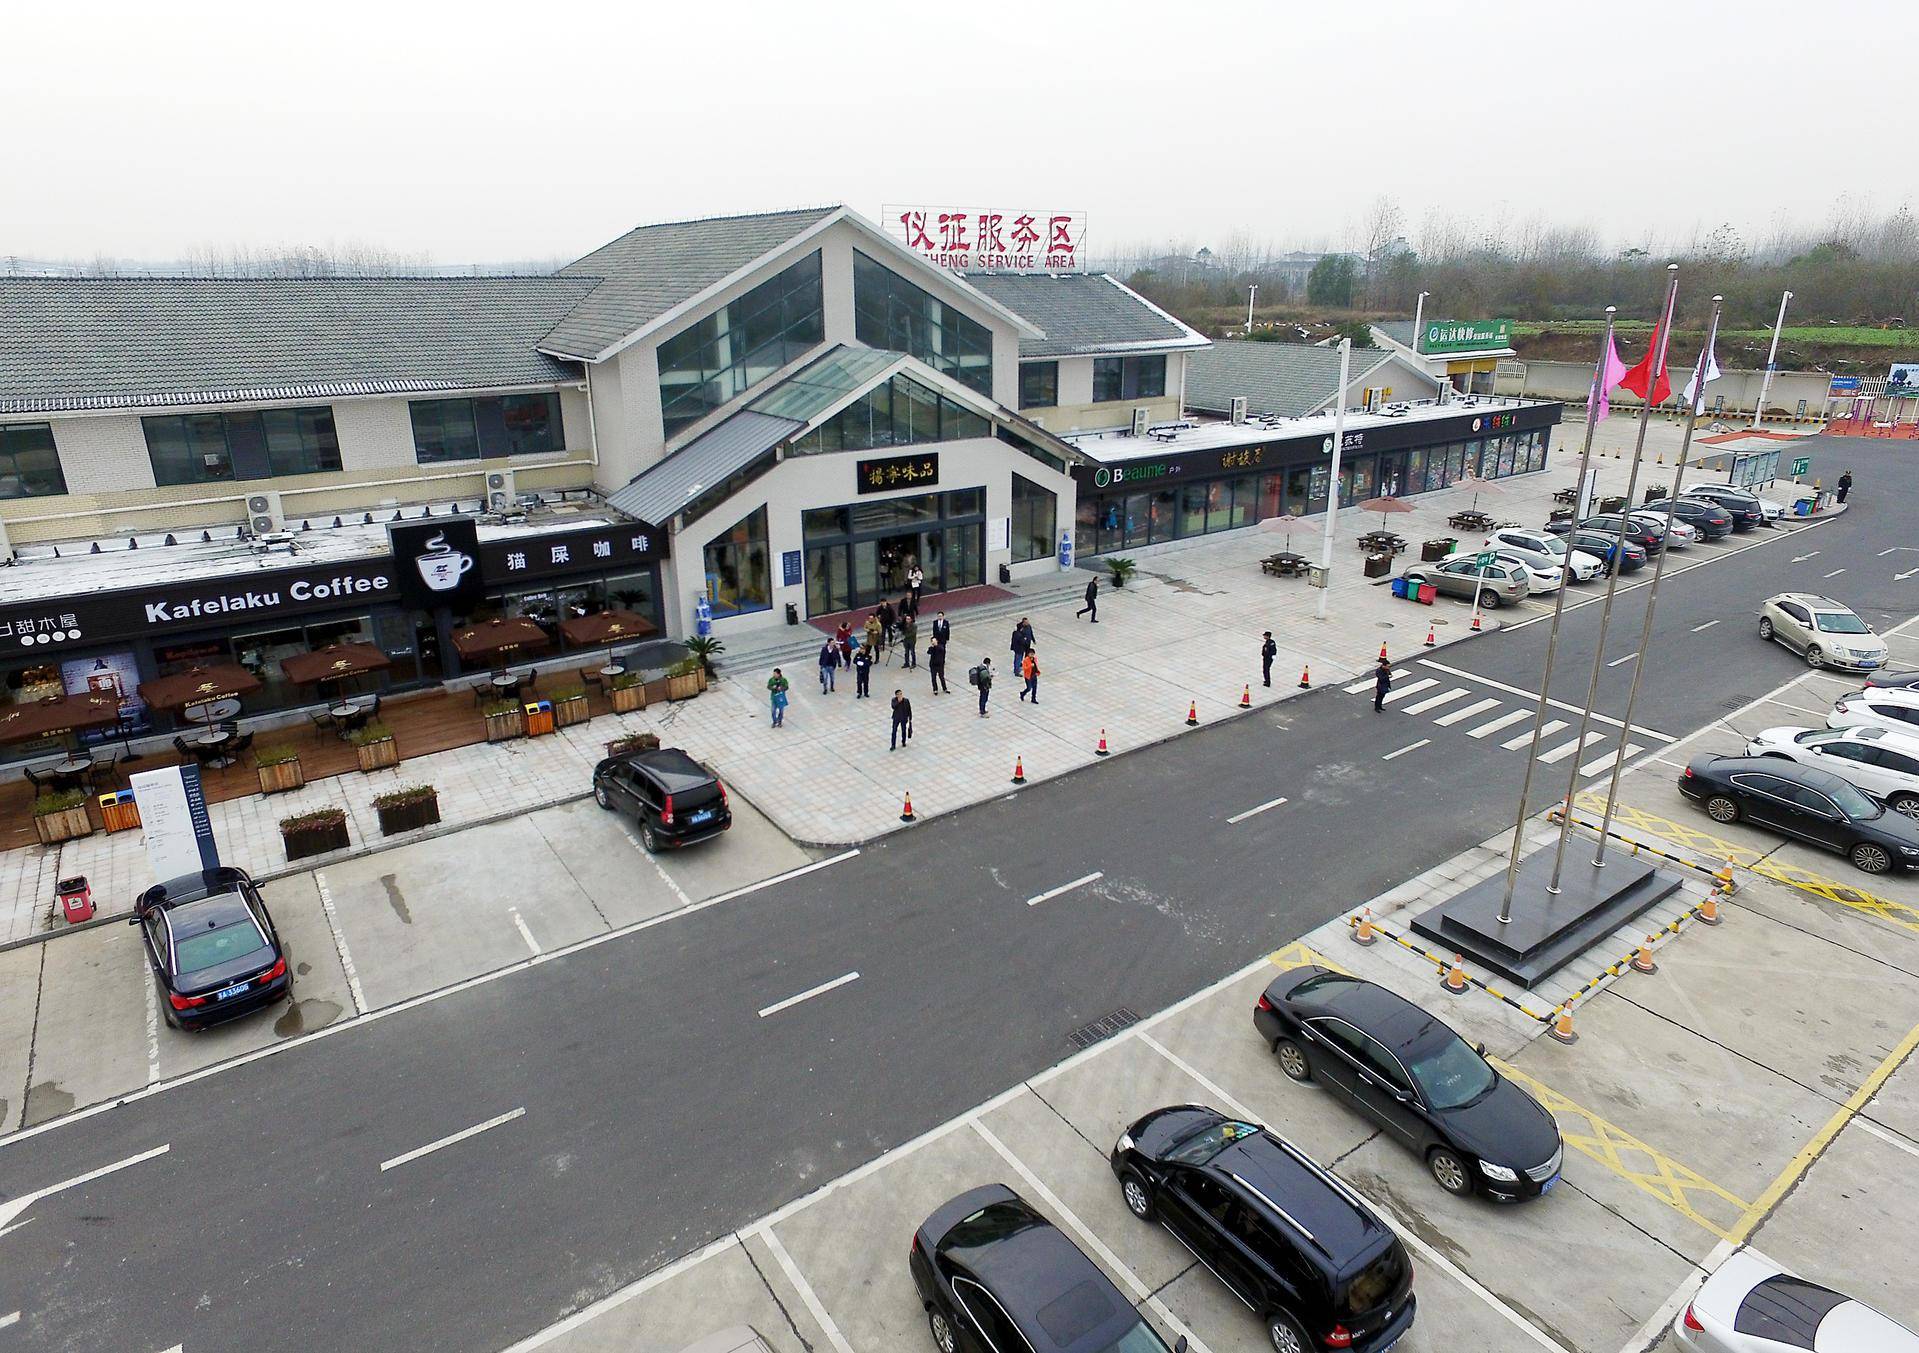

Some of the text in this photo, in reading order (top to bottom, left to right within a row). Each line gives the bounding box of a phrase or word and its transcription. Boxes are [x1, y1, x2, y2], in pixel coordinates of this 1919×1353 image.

[900, 211, 1075, 254] 仪征服务区
[923, 253, 1076, 269] HENG SERVICE AREA
[1113, 463, 1166, 483] Beaume
[507, 535, 649, 571] 猫屎咖啡
[1489, 552, 1495, 564] P
[145, 576, 389, 623] Kafelaku Coffee
